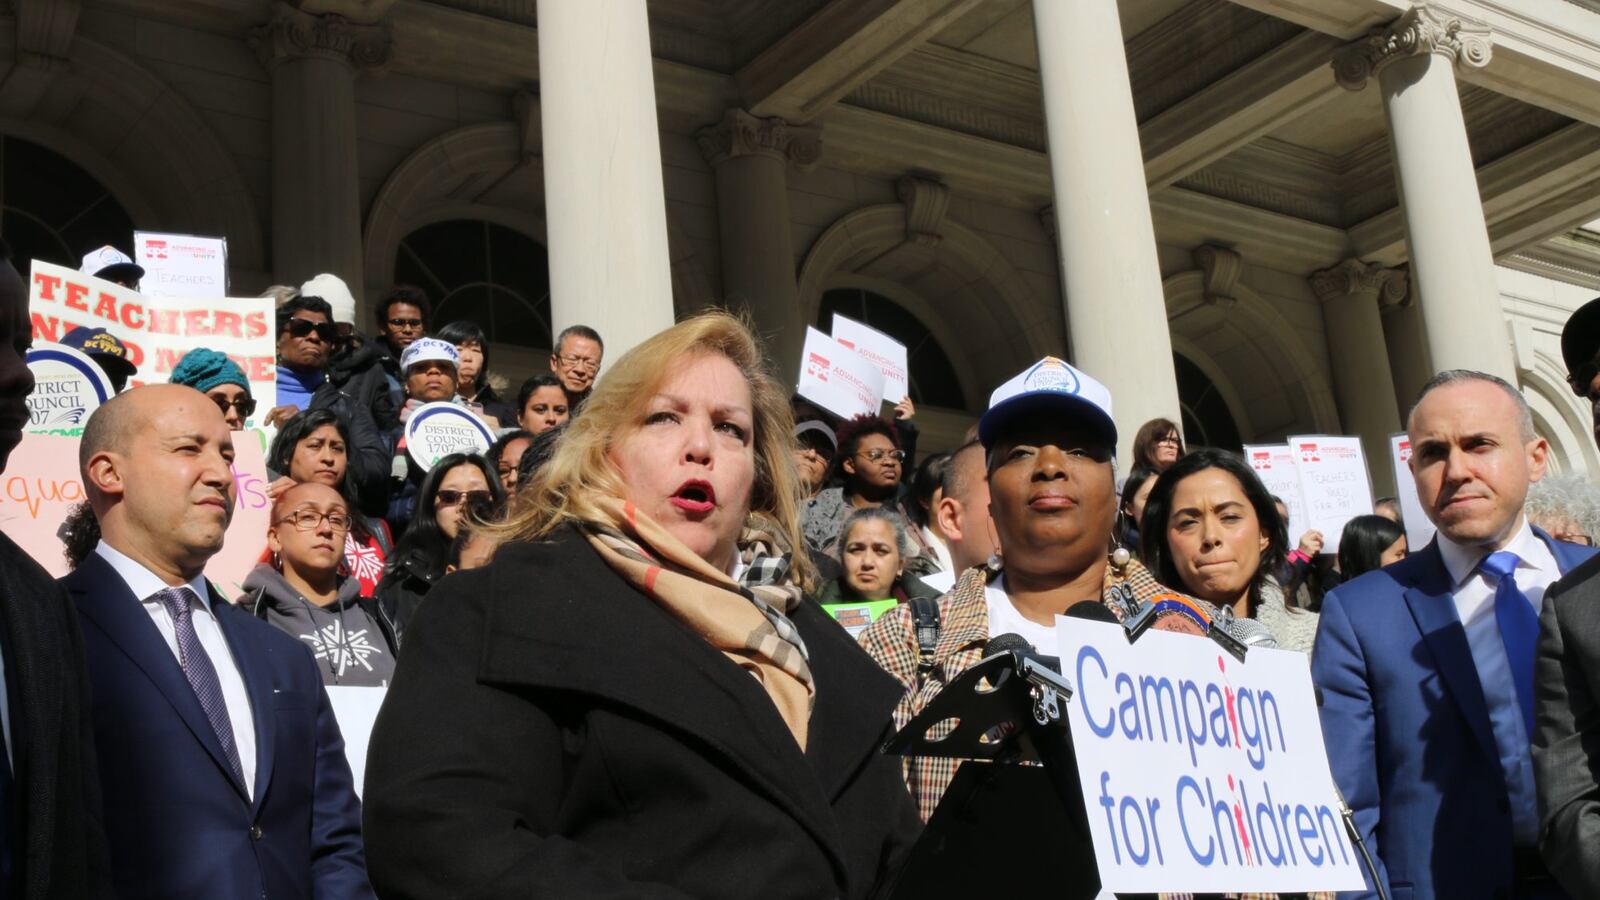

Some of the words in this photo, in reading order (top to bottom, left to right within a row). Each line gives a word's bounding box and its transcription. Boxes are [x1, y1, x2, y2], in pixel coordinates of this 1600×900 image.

[34, 273, 268, 338] TEACHERS
[881, 367, 905, 383] UNITY
[425, 425, 475, 437] DISTRICT
[425, 435, 478, 447] COUNCIL
[427, 443, 455, 453] 1707
[1076, 645, 1286, 771] Campaign
[1099, 771, 1165, 867] for
[1176, 774, 1350, 869] Children
